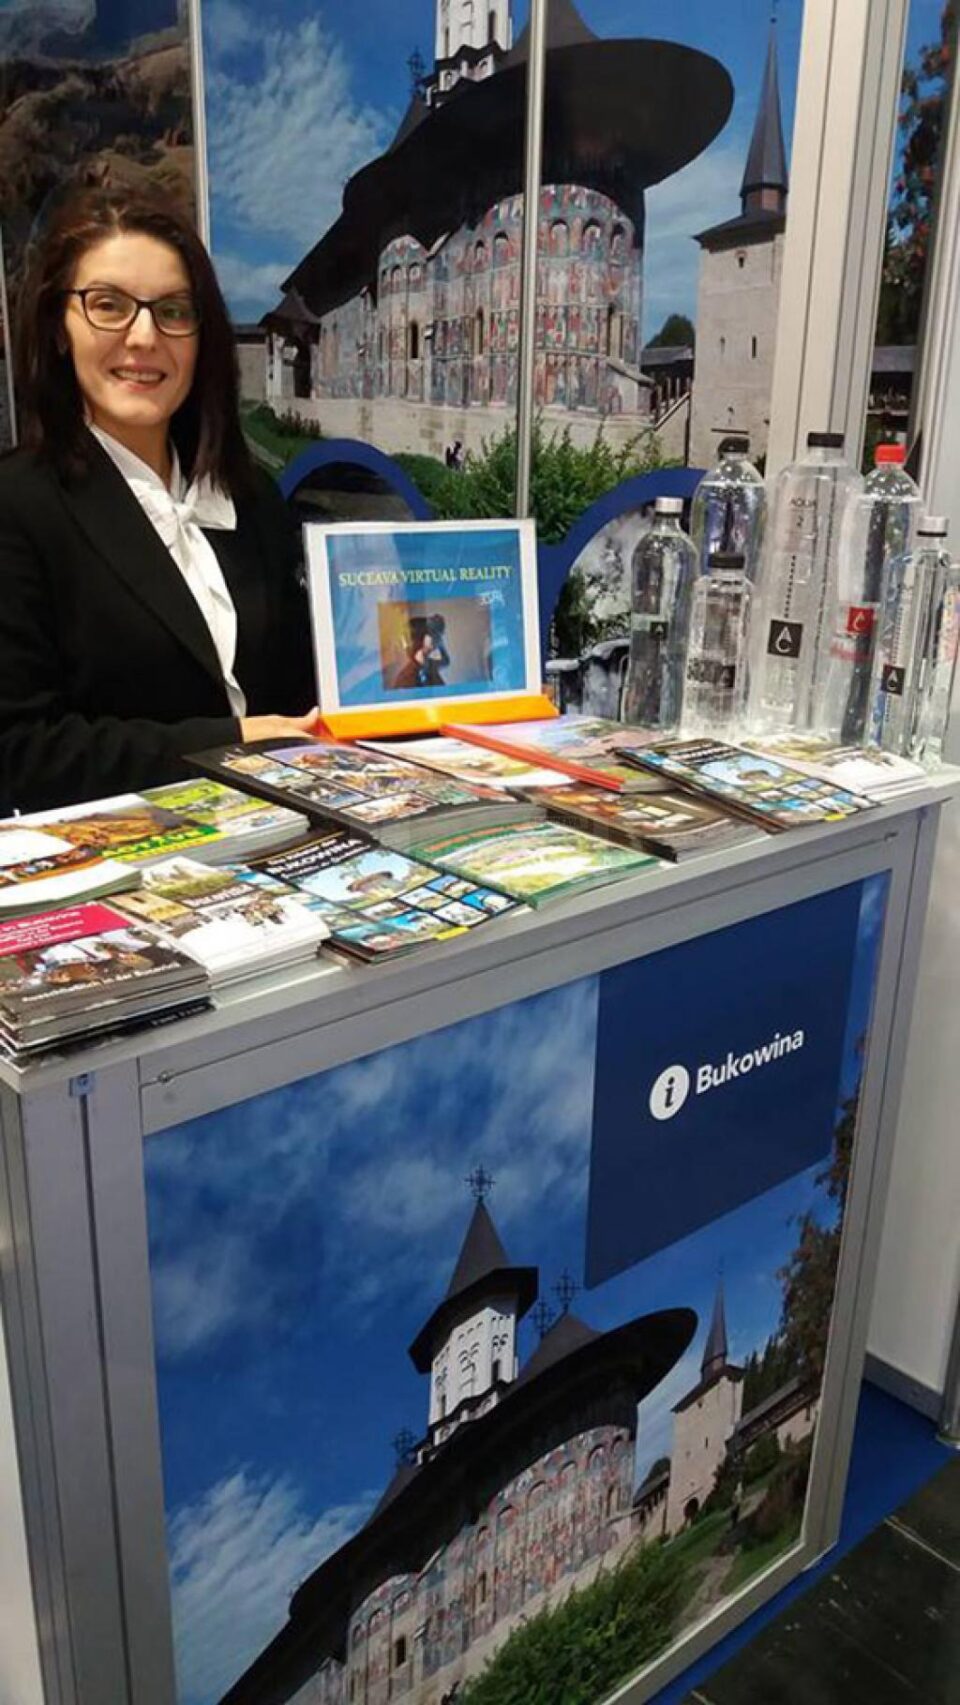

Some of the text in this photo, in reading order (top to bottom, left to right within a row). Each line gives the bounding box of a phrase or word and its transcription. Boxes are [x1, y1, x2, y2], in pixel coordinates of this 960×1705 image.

[338, 566, 513, 586] SUCEAVA VIRTUAL REALITY
[696, 1029, 805, 1095] Bukowina
